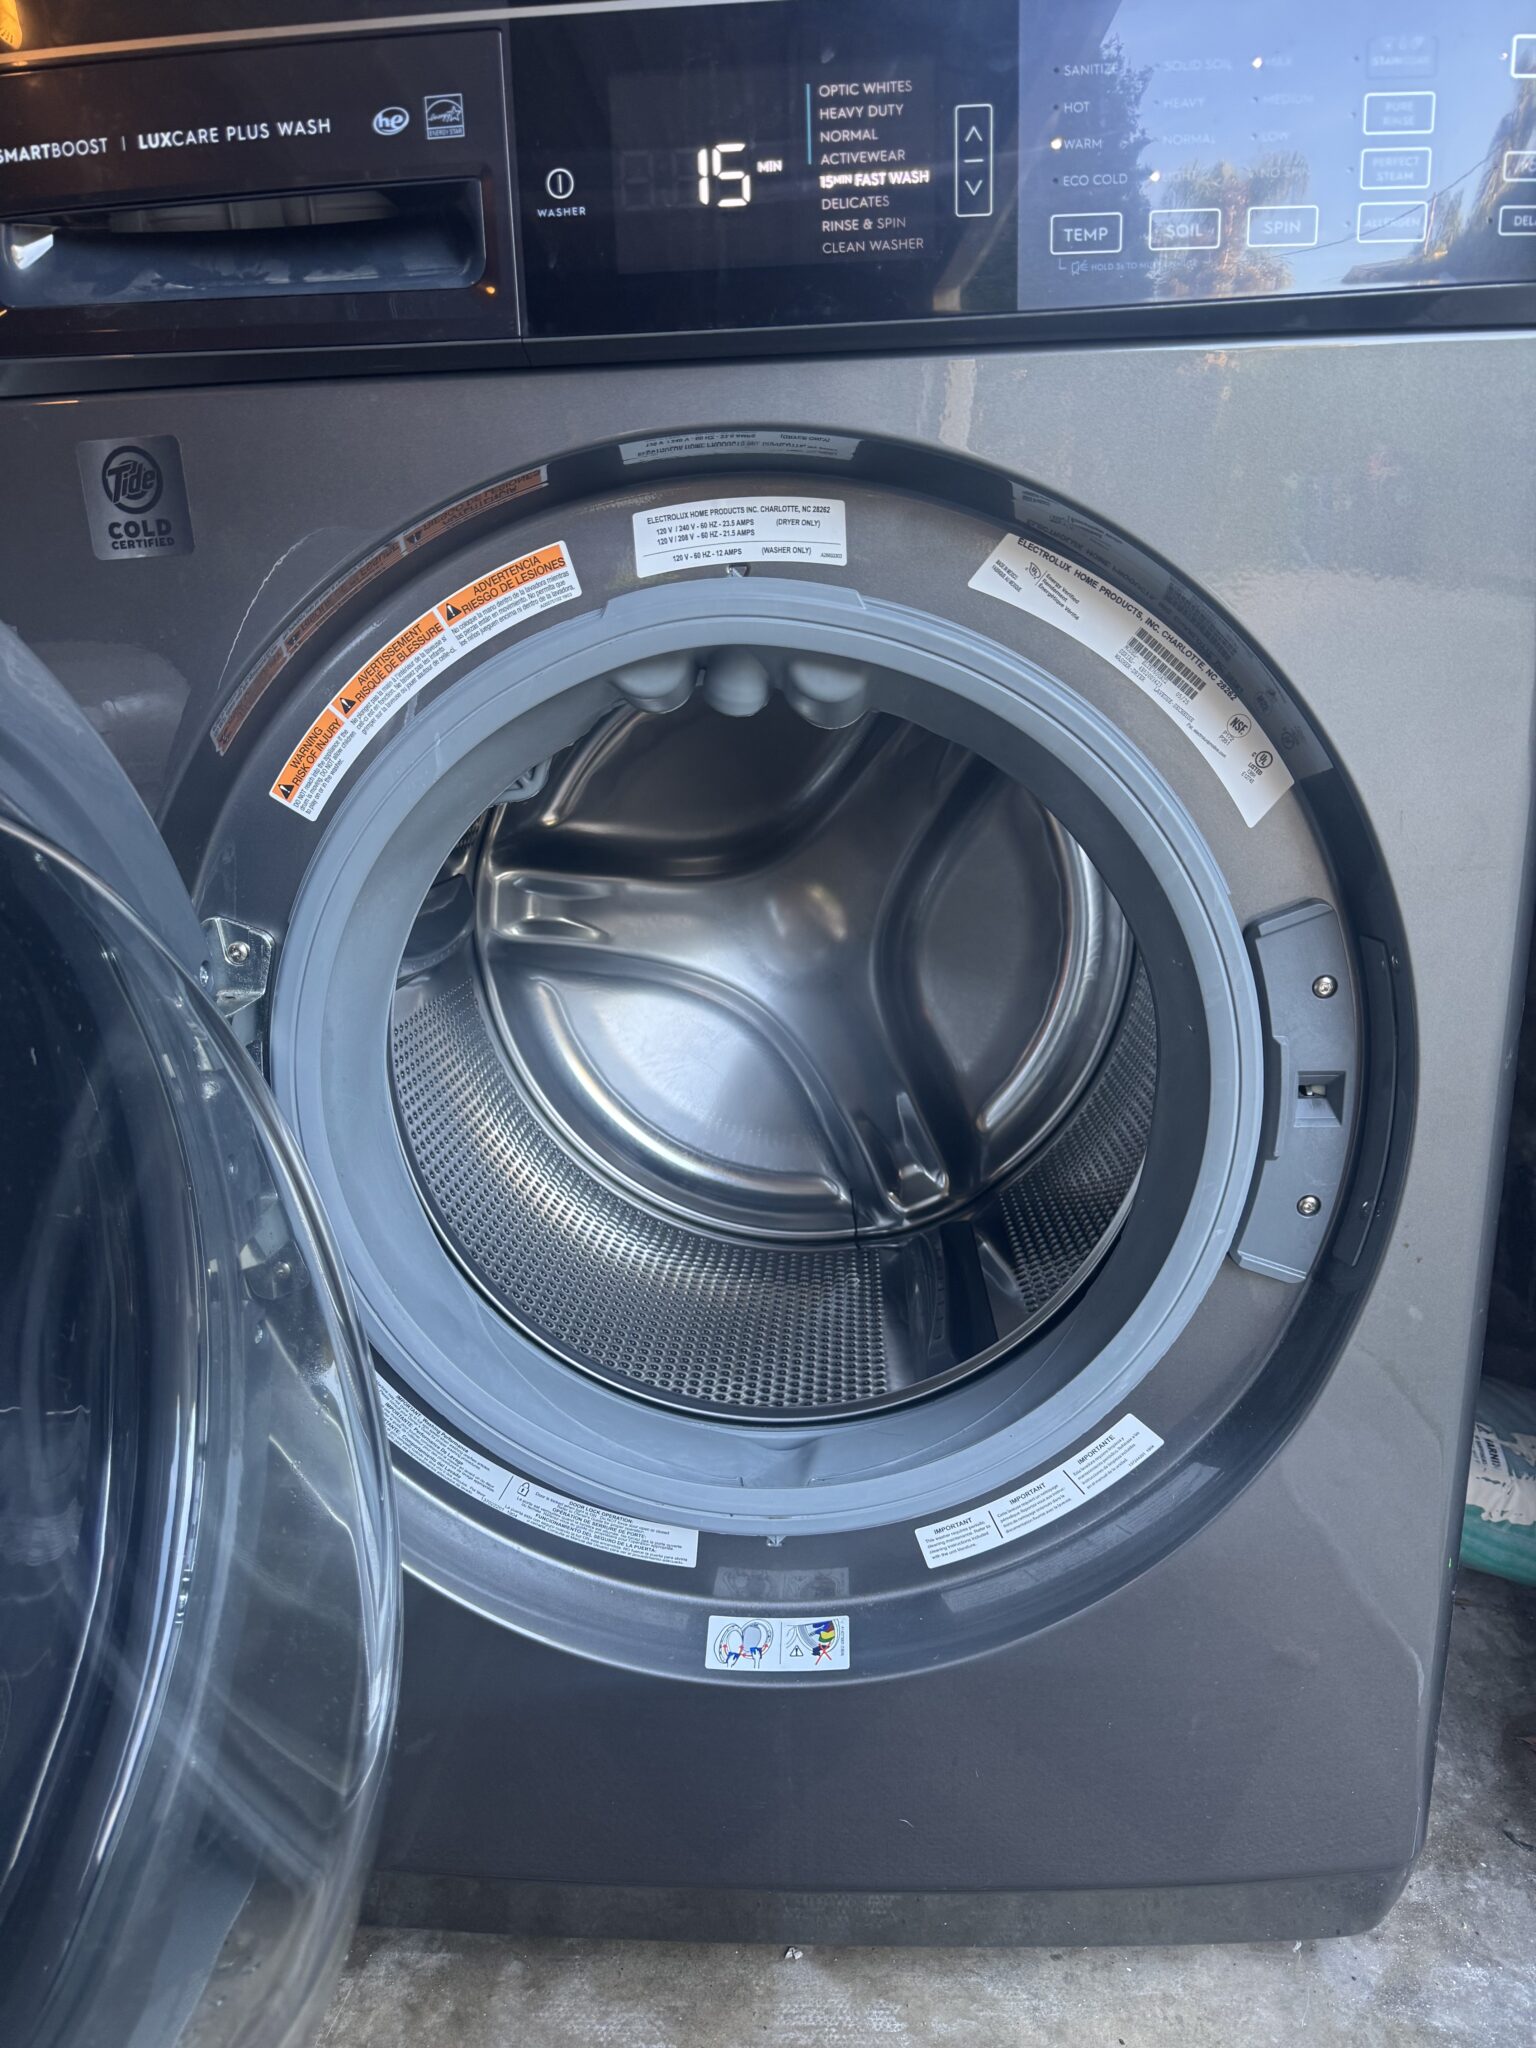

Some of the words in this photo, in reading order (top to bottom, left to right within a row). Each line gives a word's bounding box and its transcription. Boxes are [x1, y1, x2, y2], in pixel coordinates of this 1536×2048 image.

[1064, 62, 1119, 76] SANITIZE
[819, 83, 859, 97] OPTIC
[863, 80, 912, 94] WHITES
[1064, 102, 1090, 113] HOT
[1164, 98, 1205, 108] HEAVY
[820, 105, 864, 120] HEAVY
[868, 104, 903, 118] DUTY
[138, 128, 219, 151] LUXCARE
[226, 123, 270, 142] PLUS
[277, 118, 331, 136] WASH
[429, 128, 448, 138] ENERGY
[449, 128, 463, 137] STAR
[820, 128, 878, 142] NORMAL
[1164, 135, 1215, 145] NORMAL
[1064, 138, 1102, 149] WARM
[821, 149, 905, 165] ACTIVEWEAR
[697, 143, 751, 207] 15
[758, 160, 782, 173] MIN
[855, 171, 886, 187] FAST
[889, 169, 929, 184] WASH
[1063, 175, 1090, 187] ECO
[1093, 173, 1128, 185] COLD
[821, 195, 890, 210] DELICATES
[537, 207, 586, 218] WASHER
[1514, 215, 1536, 226] DEL
[822, 219, 859, 232] RINSE
[864, 219, 872, 231] &
[877, 216, 906, 229] SPIN
[1165, 225, 1202, 238] SOIL
[1264, 221, 1301, 234] SPIN
[1064, 228, 1108, 242] TEMP
[822, 240, 865, 255] CLEAN
[869, 237, 924, 252] WASHER
[1092, 263, 1113, 271] HOLD
[107, 461, 156, 503] Tide
[647, 512, 688, 524] ELECTROLUX
[690, 509, 708, 518] HOME
[710, 507, 744, 516] PRODUCTS
[761, 505, 800, 513] CHARLOTTE,
[109, 518, 171, 539] COLD
[657, 526, 667, 535] 120
[679, 524, 689, 532] 240
[723, 520, 735, 528] 23.5
[737, 519, 754, 527] AMPS
[776, 519, 799, 527] (DRYER
[802, 519, 821, 528] ONLY)
[112, 537, 175, 550] CERTIFIED
[657, 537, 667, 545] 120
[669, 536, 673, 544] V
[737, 529, 755, 537] AMPS
[673, 554, 684, 562] 120
[724, 548, 742, 556] AMPS
[762, 547, 791, 555] (WASHER
[793, 547, 811, 555] ONLY)
[471, 554, 540, 596] ADVERTENCIA
[460, 586, 499, 614] RIESGO
[498, 579, 513, 593] DE
[514, 555, 566, 585] LESIONES
[495, 594, 512, 607] dentro
[524, 578, 546, 592] lavadora
[546, 569, 569, 583] mientras
[1040, 578, 1068, 602] Rendement
[1044, 572, 1063, 589] Energy
[1060, 586, 1080, 604] Verified
[1016, 536, 1072, 572] ELECTROLUX
[1073, 569, 1099, 589] HOME
[1098, 585, 1145, 620] PRODUCTS,
[1144, 617, 1162, 633] INC.
[1159, 629, 1206, 671] CHARLOTTE,
[1205, 668, 1217, 681] NC
[1215, 679, 1237, 701] 28262
[355, 622, 424, 686] AVERTISSEMENT
[383, 658, 398, 673] DE
[396, 621, 443, 662] BLESSURE
[289, 726, 323, 769] WARNING
[291, 762, 310, 786] RISK
[305, 749, 318, 764] OF
[314, 717, 342, 751] INJURY
[293, 799, 301, 807] DO
[297, 789, 306, 800] NOT
[317, 759, 325, 768] the
[340, 728, 348, 737] the
[319, 768, 327, 776] DO
[324, 758, 334, 769] NOT
[1076, 1434, 1115, 1464] IMPORTANTE
[1008, 1482, 1045, 1504] IMPORTANT
[933, 1517, 972, 1534] IMPORTANT
